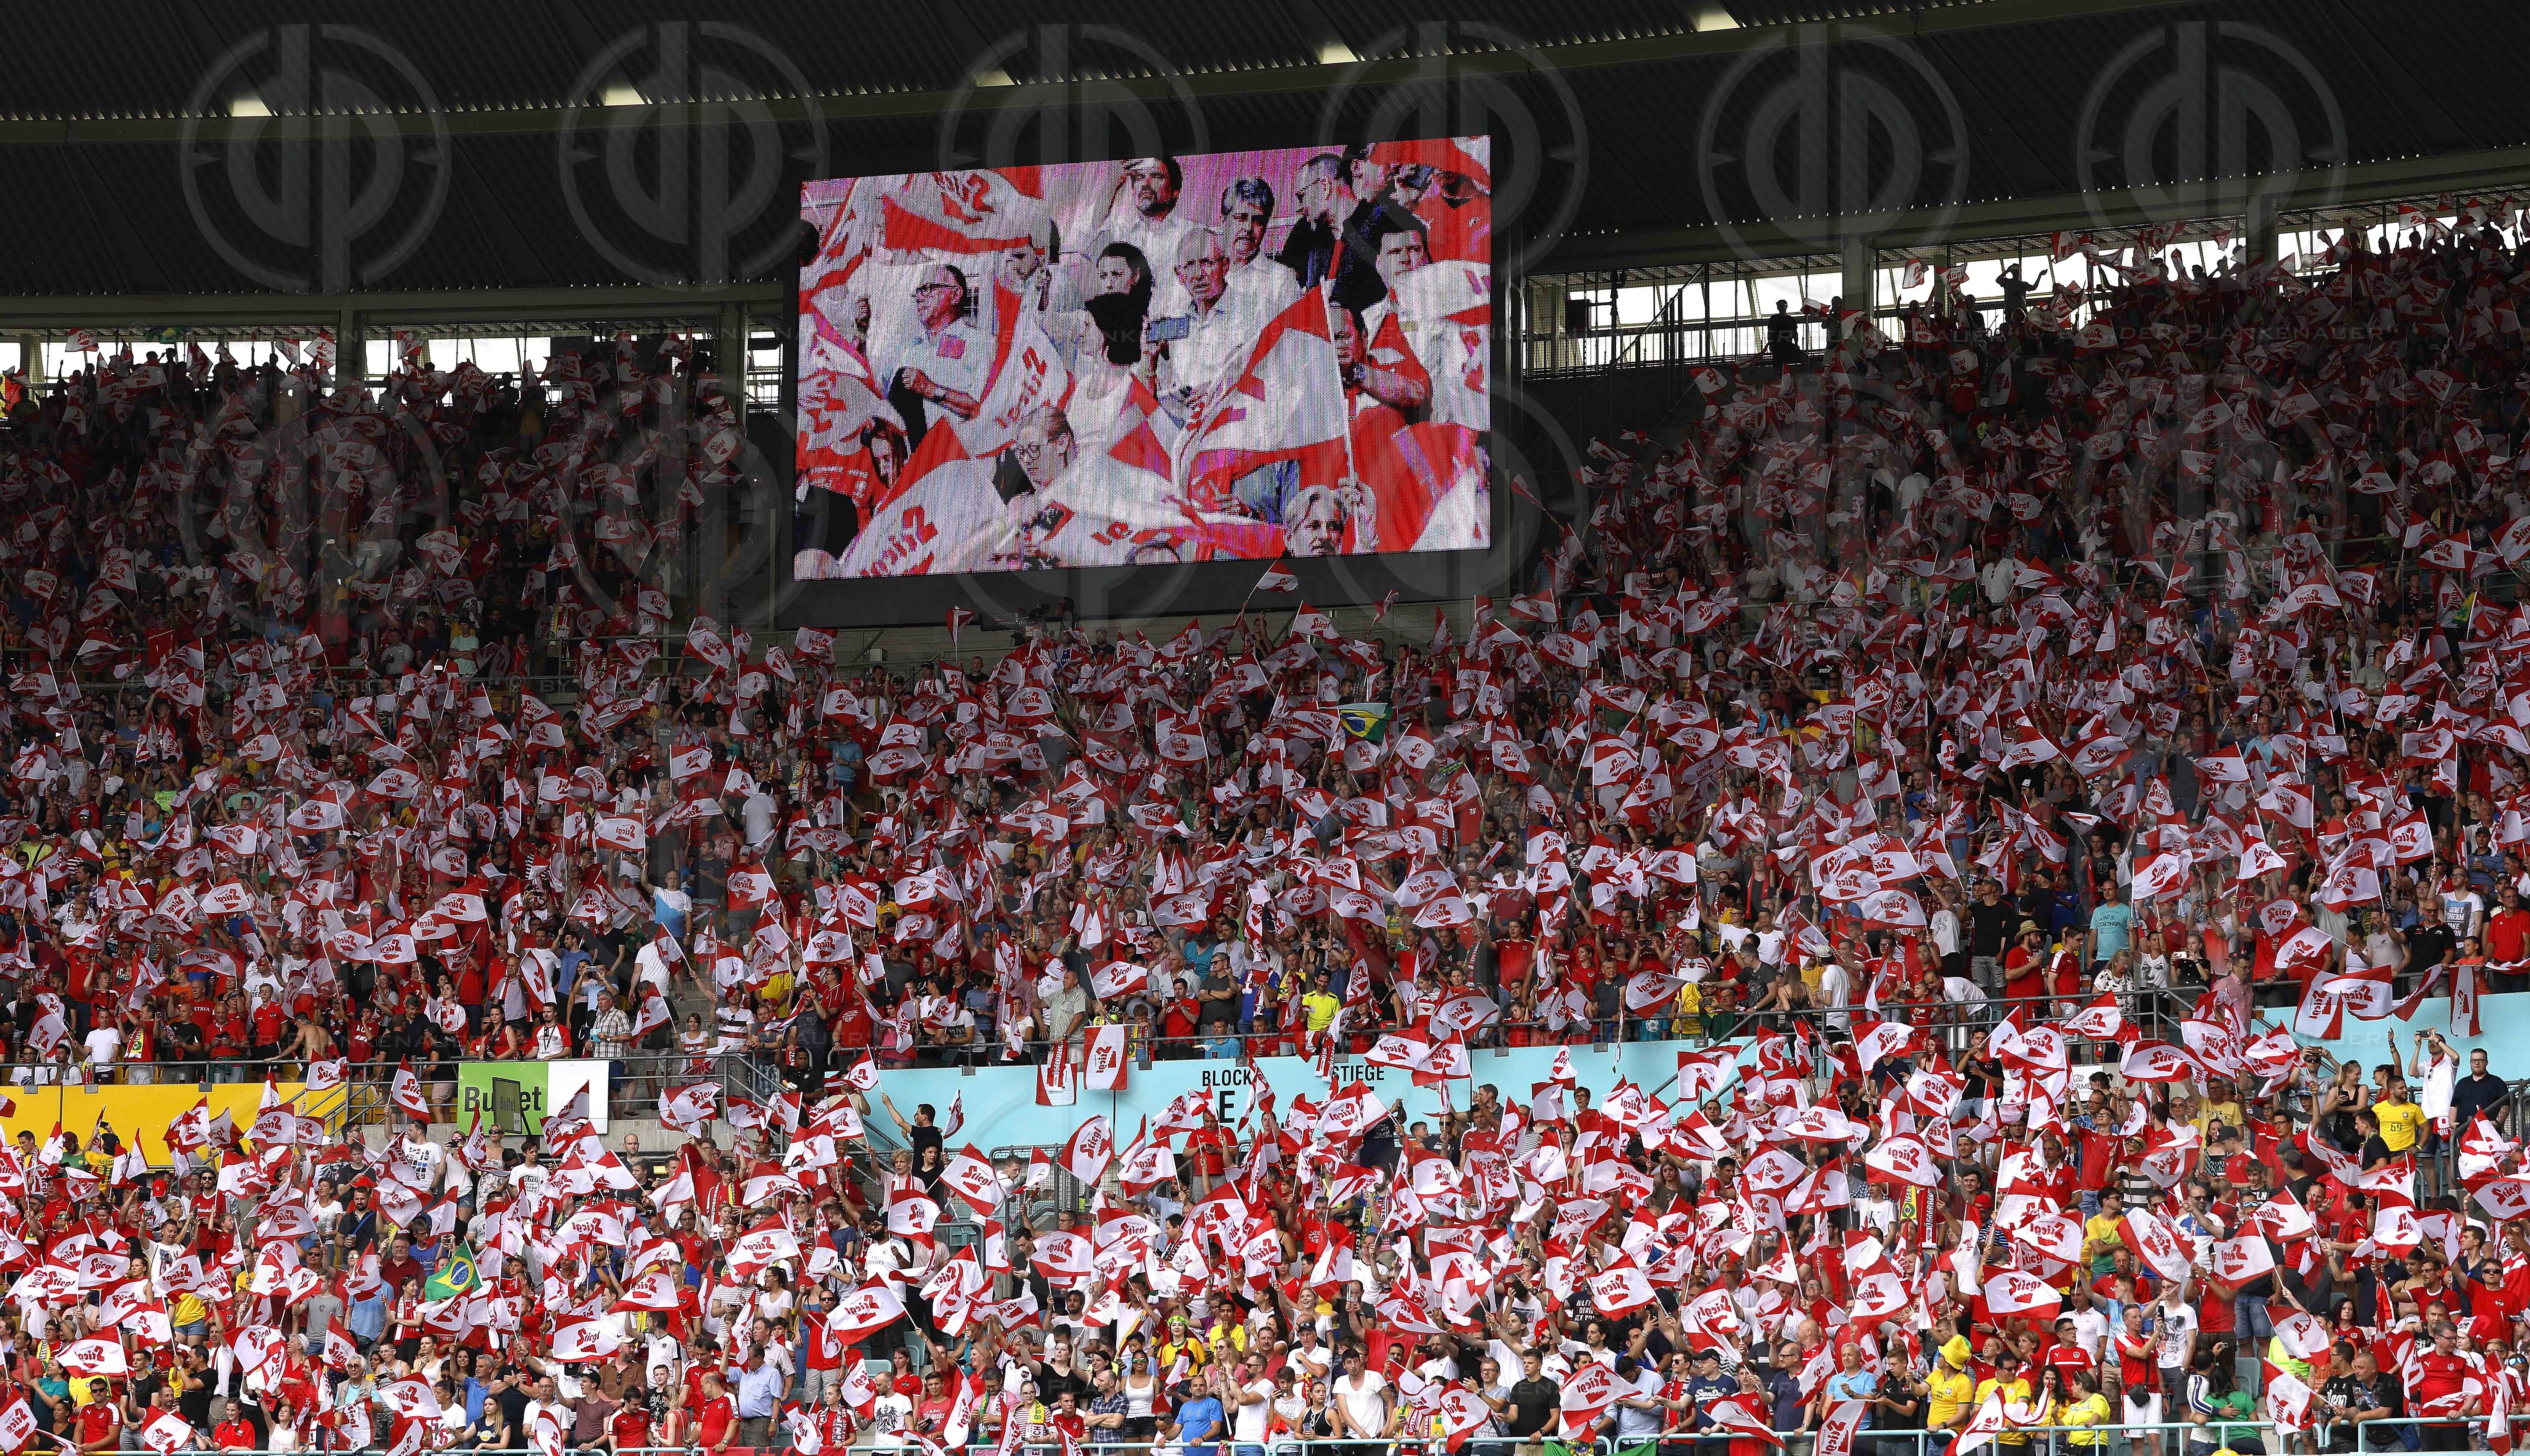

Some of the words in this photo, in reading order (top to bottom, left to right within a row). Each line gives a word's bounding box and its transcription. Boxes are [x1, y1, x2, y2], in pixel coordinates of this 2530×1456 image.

[1311, 618, 1331, 630] Stiegl
[523, 701, 543, 714] Stiegl
[2154, 786, 2168, 803] Stieg
[1543, 837, 1560, 849] Stieg
[1172, 901, 1194, 912] Stiegl
[2268, 908, 2292, 921] Stieg
[1111, 964, 1132, 982] Stiegl
[1203, 1070, 1251, 1086] BLOCK
[1334, 1065, 1385, 1081] STIEGE
[464, 1086, 542, 1112] Buet
[1219, 1091, 1235, 1122] E
[2390, 1122, 2402, 1131] 69
[1079, 1127, 1102, 1159] Stiegl
[962, 1166, 993, 1186] Stiegl
[1616, 1166, 1642, 1185] Stiegl
[2491, 1185, 2522, 1205] Stiegl
[1120, 1222, 1148, 1236] Stiegl
[1734, 1205, 1753, 1237] Stiegl
[90, 1257, 116, 1273] Stiegl
[47, 1271, 75, 1289] Stiegl
[577, 1330, 599, 1345] Stiegl
